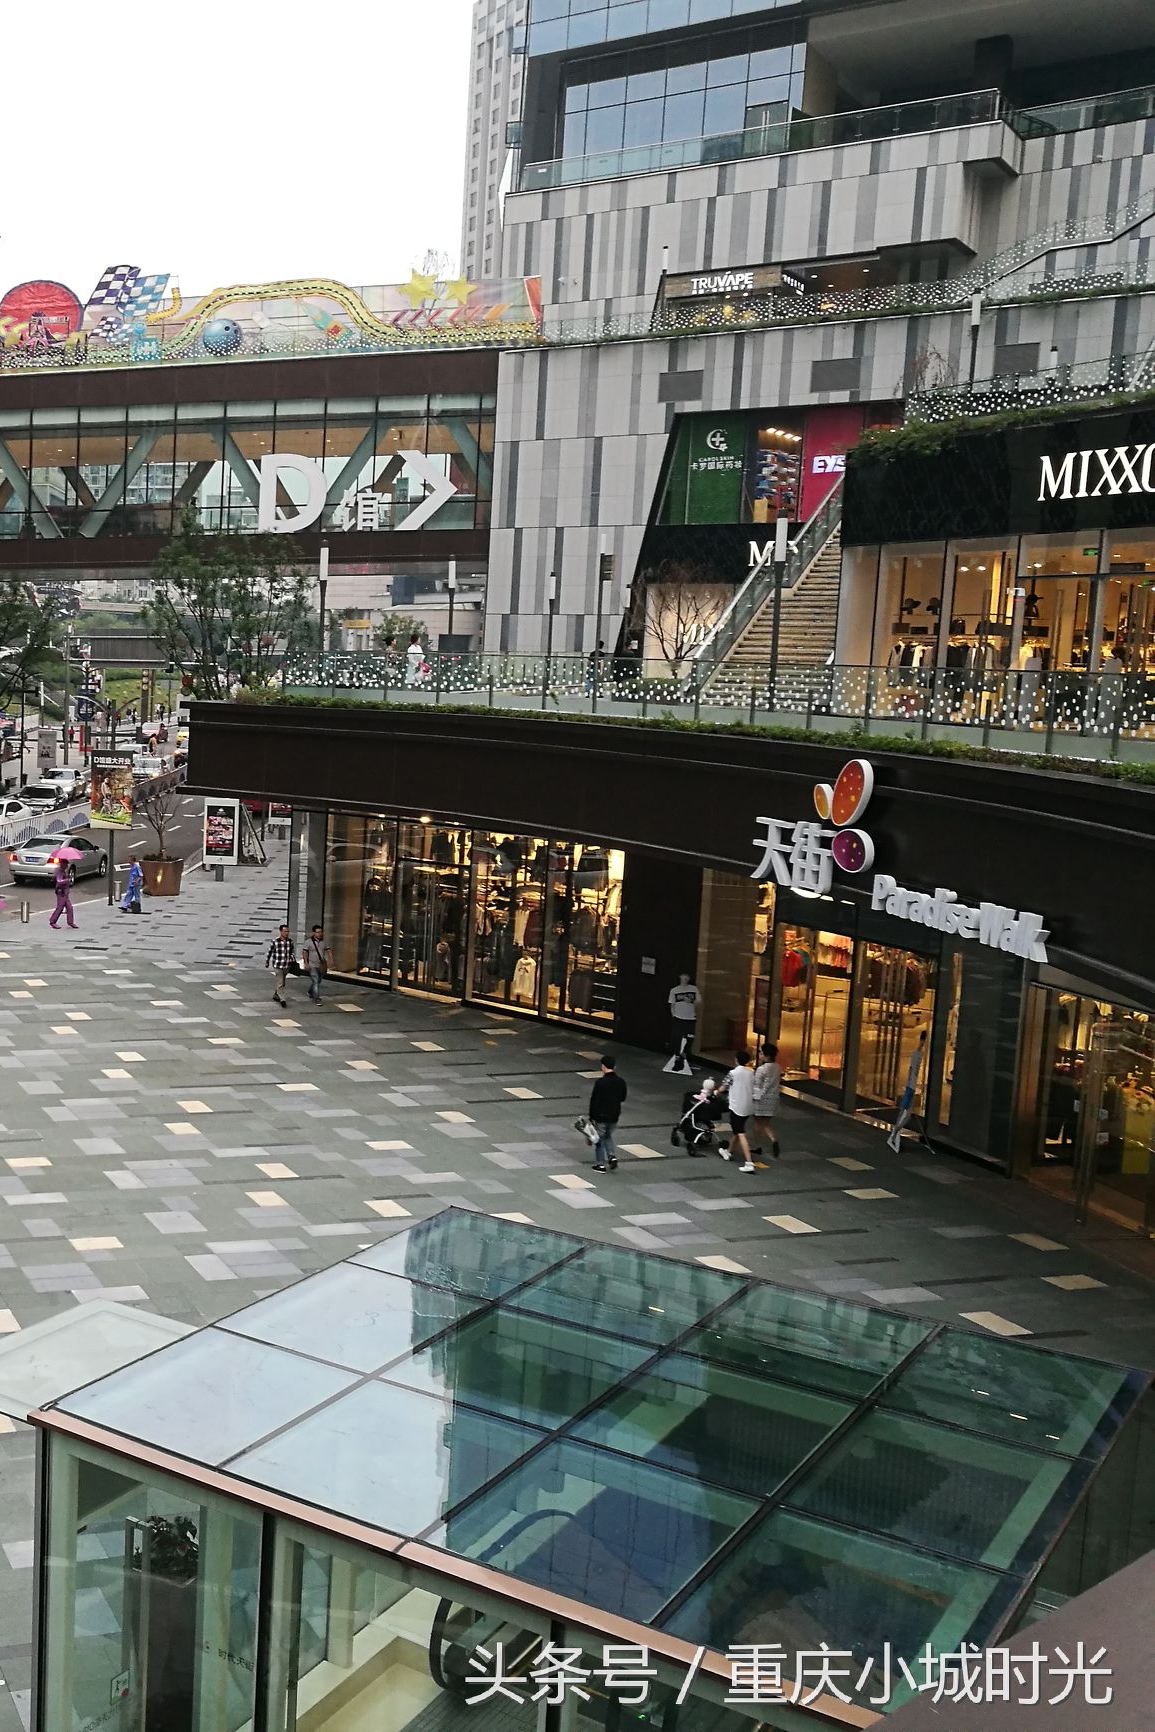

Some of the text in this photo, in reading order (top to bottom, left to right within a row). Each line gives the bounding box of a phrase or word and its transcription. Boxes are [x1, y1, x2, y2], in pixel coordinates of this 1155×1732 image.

[750, 816, 838, 894] 天街
[871, 874, 1051, 963] Paradise Walk
